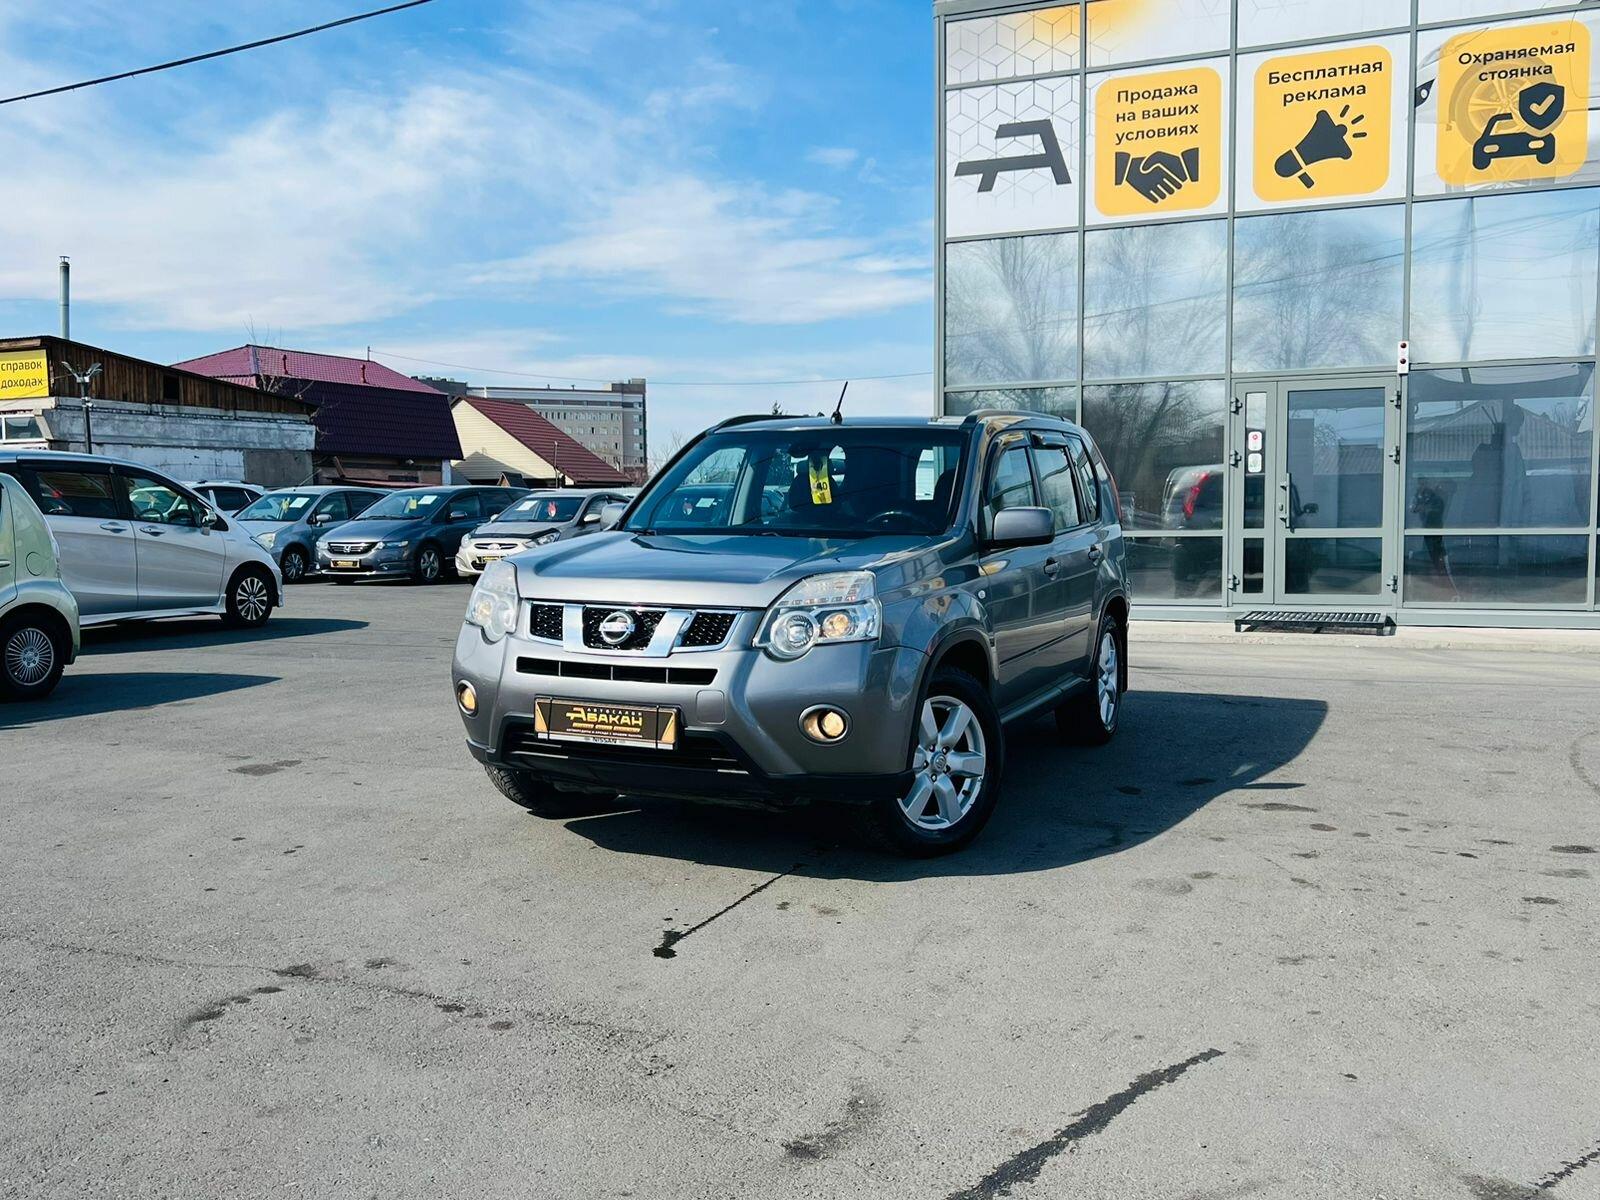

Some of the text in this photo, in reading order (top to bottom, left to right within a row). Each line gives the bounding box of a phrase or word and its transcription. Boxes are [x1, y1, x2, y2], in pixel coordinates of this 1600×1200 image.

[1458, 42, 1576, 66] Охраняемая
[1268, 60, 1384, 85] Бесплатная
[1478, 64, 1553, 82] стоянка
[1116, 83, 1199, 105] Продажа
[1282, 84, 1367, 107] реклама
[1115, 103, 1199, 123] на ваших
[1114, 124, 1199, 145] условиях
[1, 361, 42, 373] справок
[1, 378, 43, 389] доходах
[566, 707, 643, 726] АБАКАН
